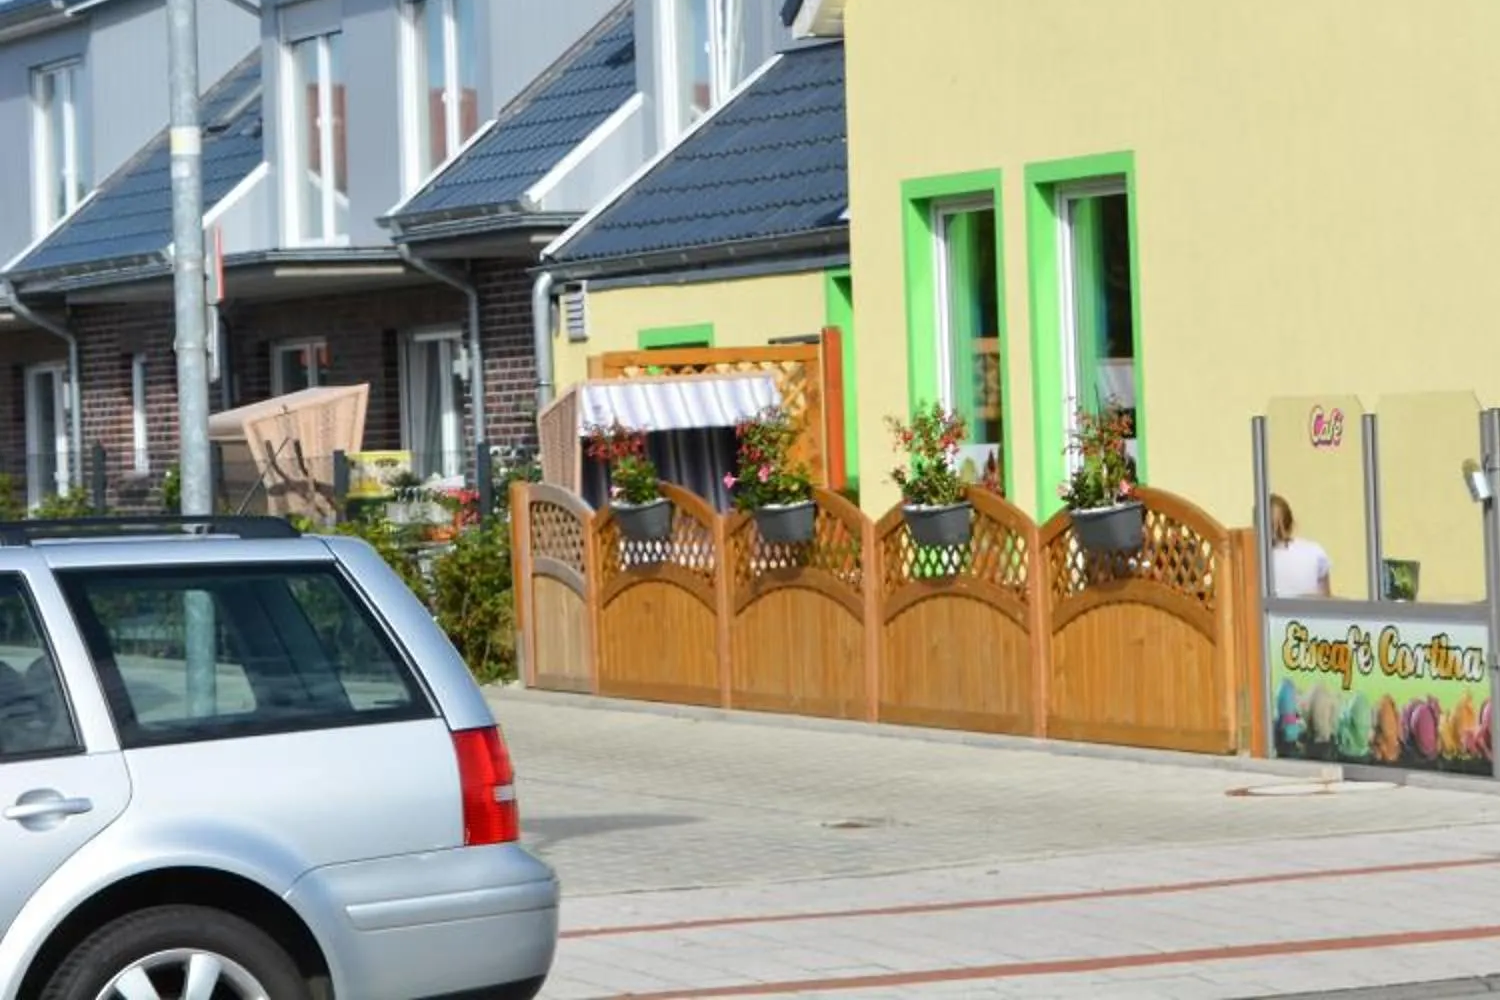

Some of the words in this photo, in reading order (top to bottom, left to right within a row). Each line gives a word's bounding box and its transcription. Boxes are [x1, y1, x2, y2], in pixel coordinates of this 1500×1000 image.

[1309, 405, 1344, 449] Café
[1282, 620, 1374, 691] Eiscafé
[1378, 625, 1485, 682] Cortina
